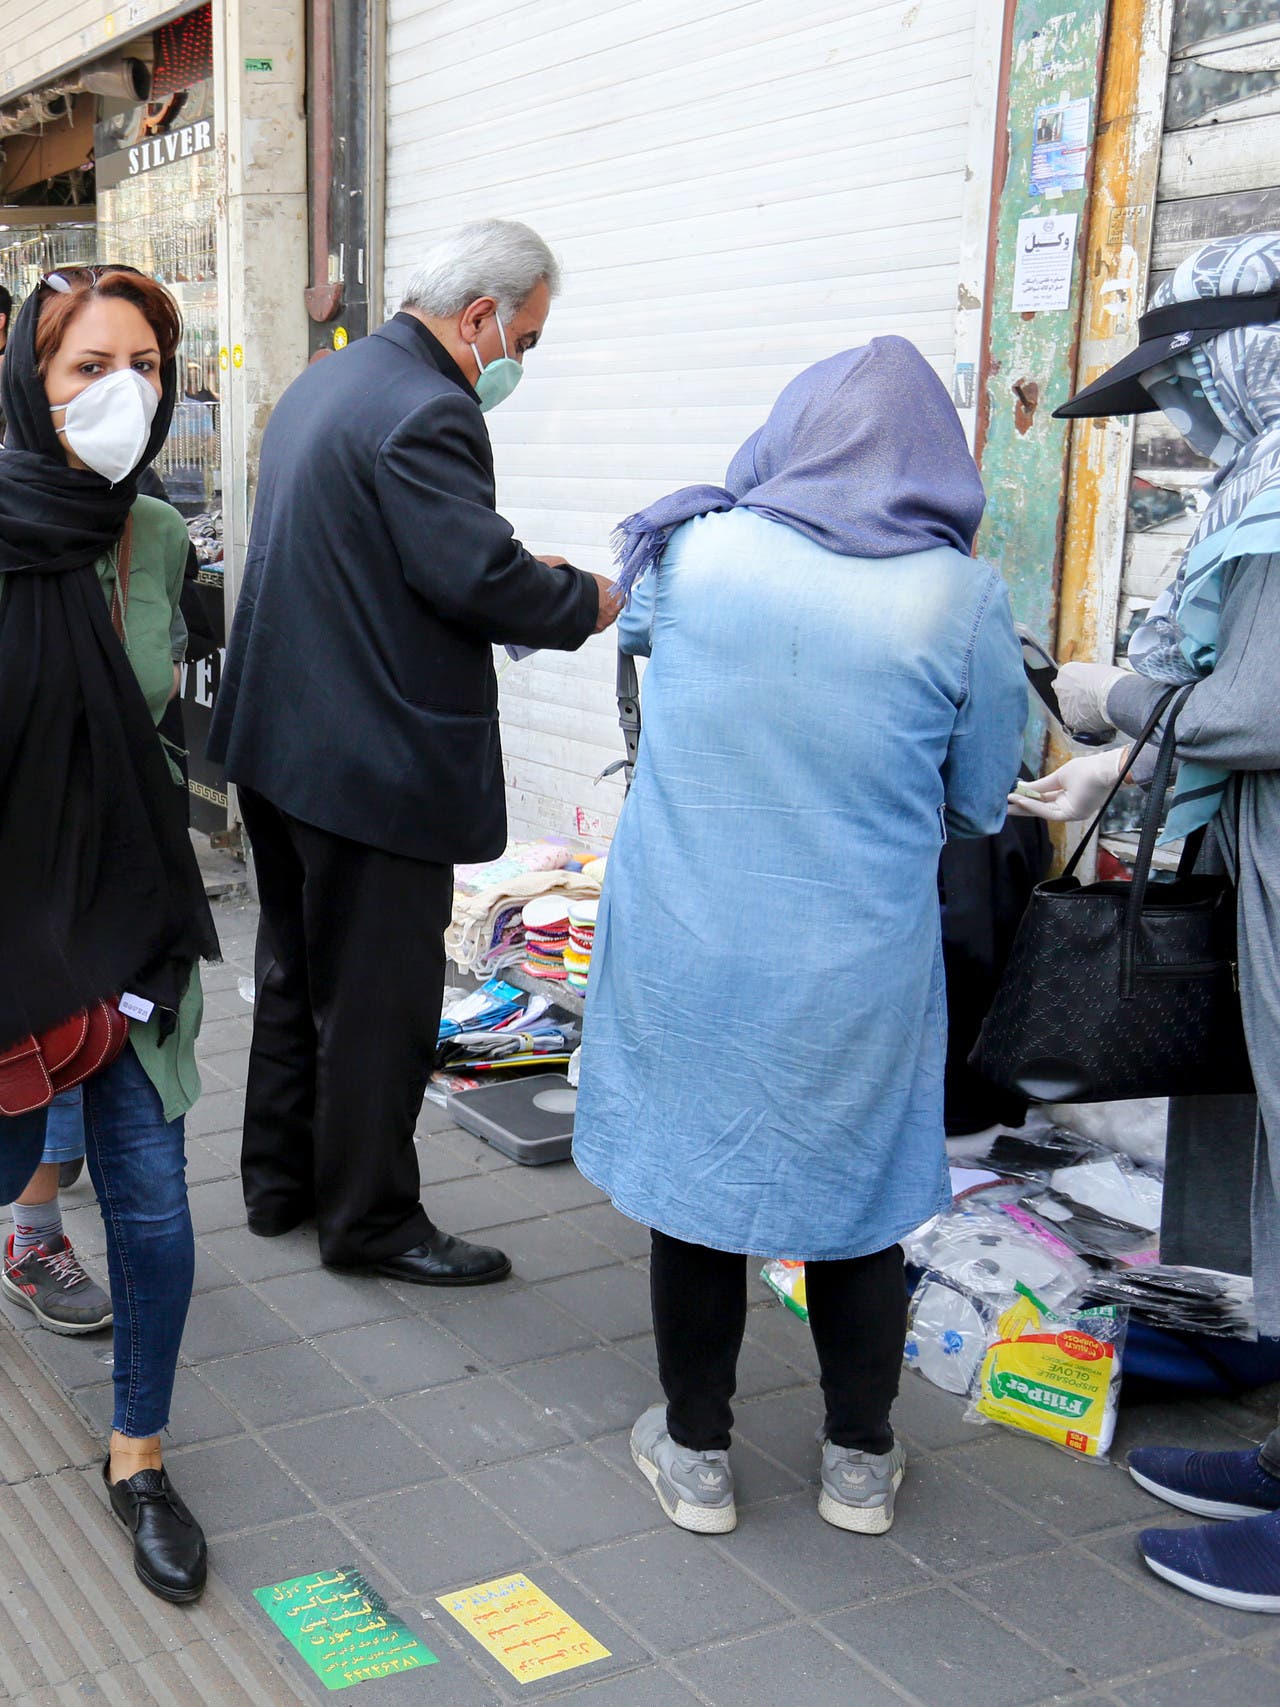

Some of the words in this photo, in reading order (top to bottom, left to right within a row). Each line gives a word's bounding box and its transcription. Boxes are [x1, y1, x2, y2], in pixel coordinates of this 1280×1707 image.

[128, 120, 211, 175] SILVER
[1024, 232, 1070, 254] وکیل
[1038, 1370, 1099, 1393] DISPOSABLE
[1047, 1363, 1090, 1381] GLOVE
[286, 1587, 362, 1617] بوتاکس
[330, 1601, 373, 1622] لیفت
[300, 1616, 328, 1633] بینی
[356, 1615, 387, 1633] لیفت
[310, 1629, 352, 1646] صورت
